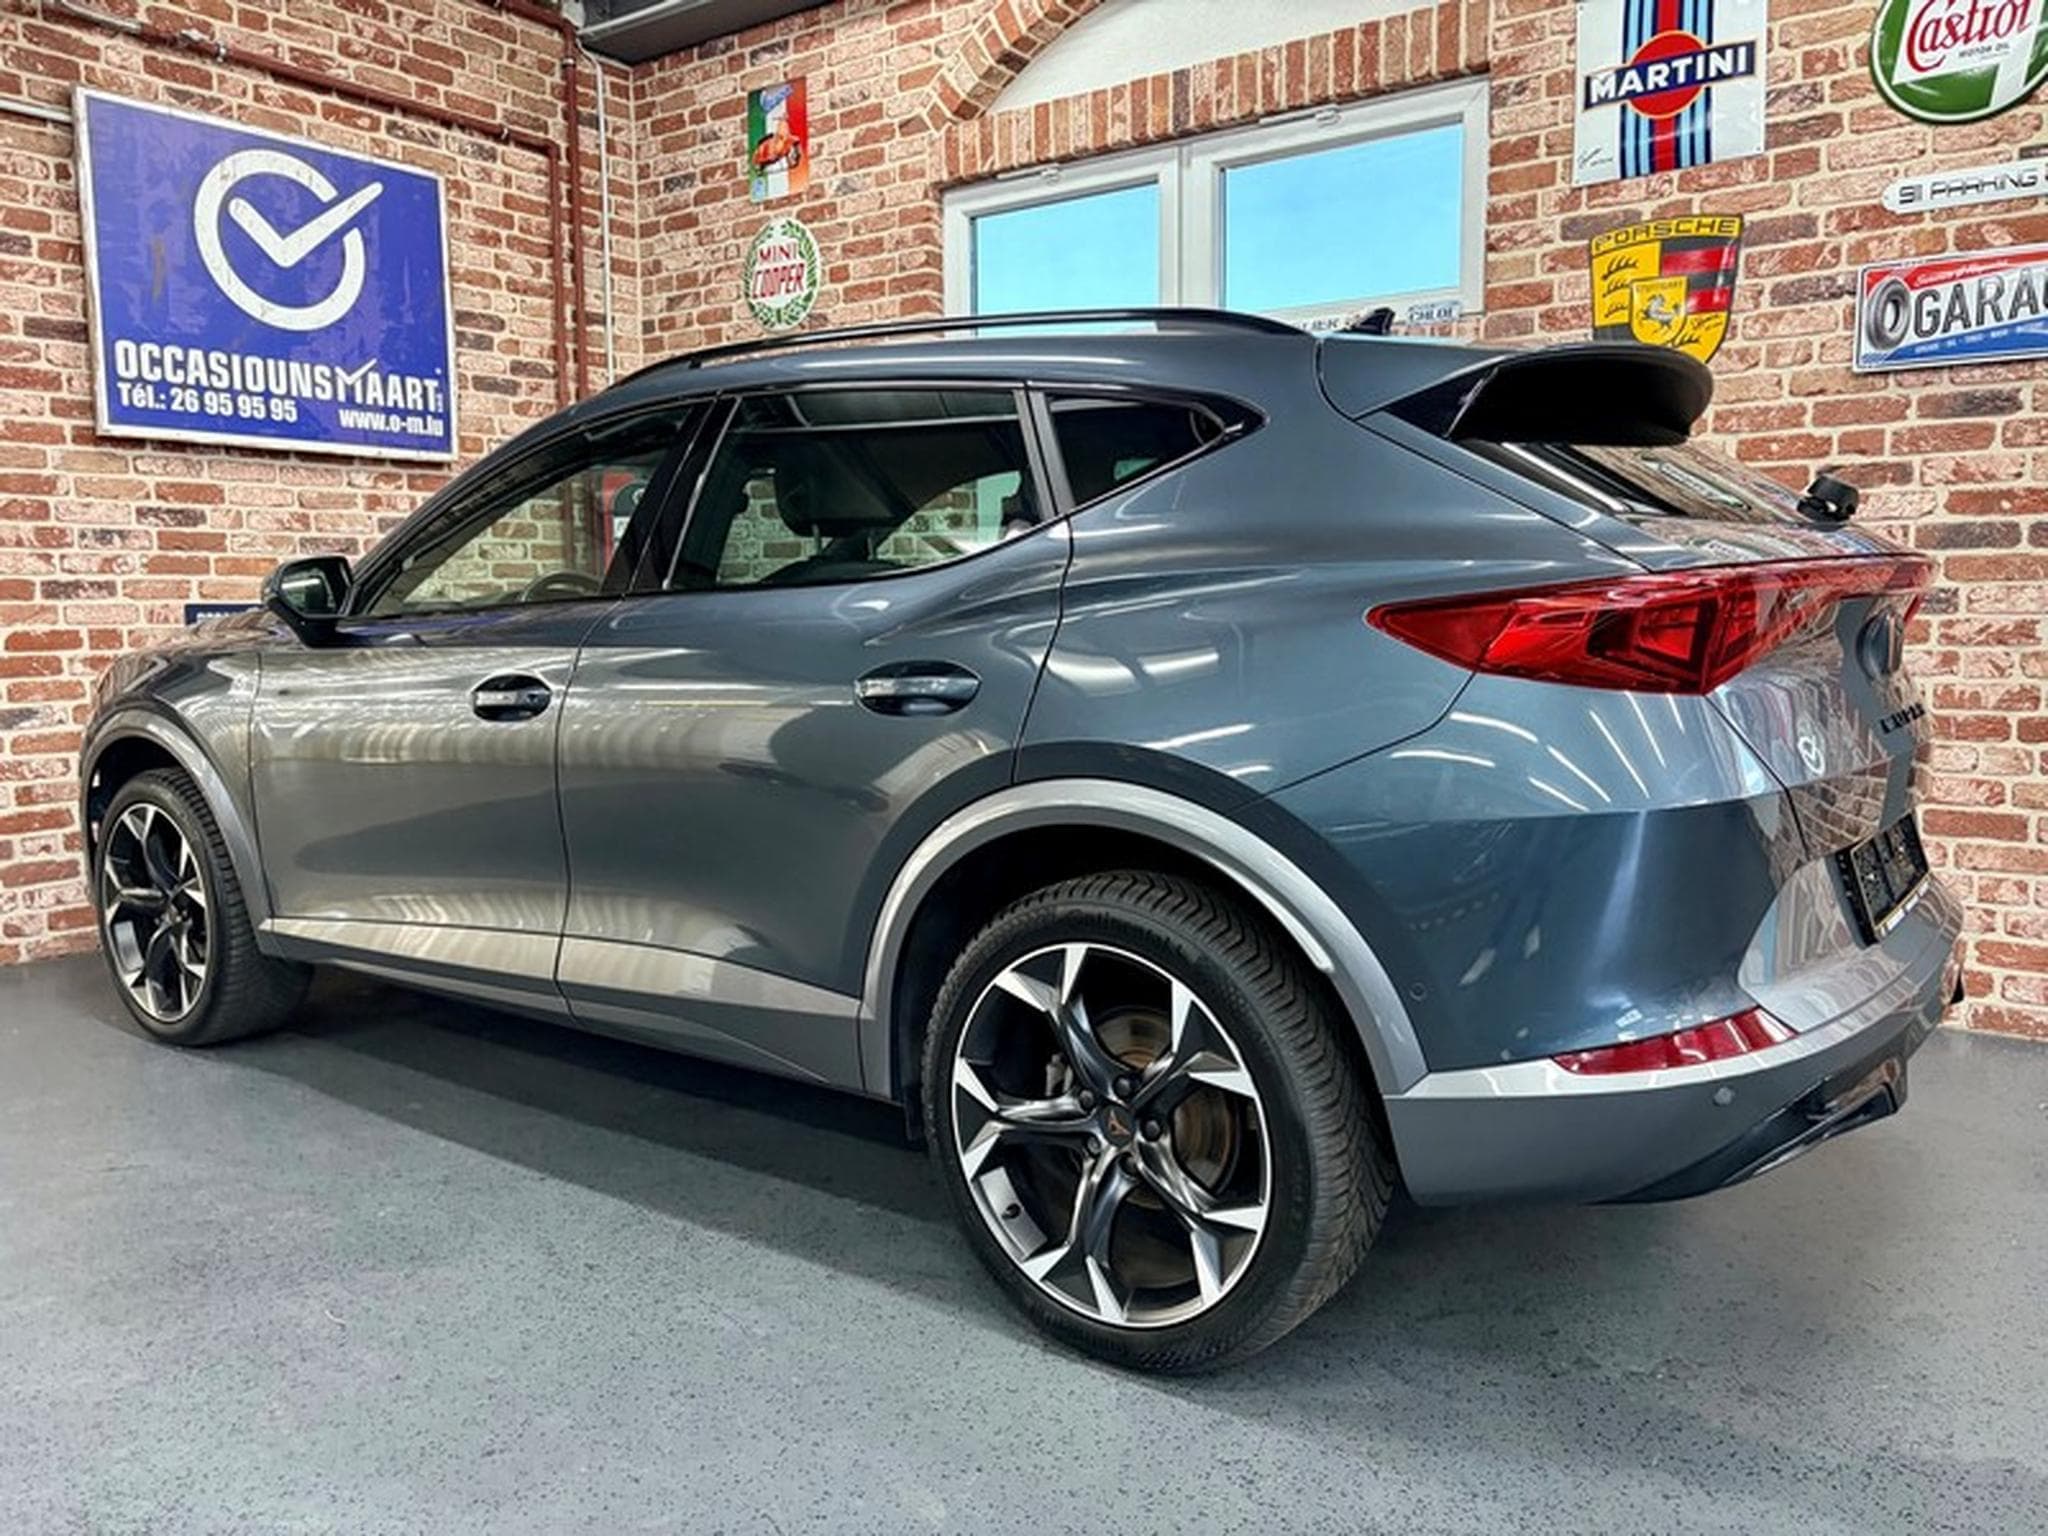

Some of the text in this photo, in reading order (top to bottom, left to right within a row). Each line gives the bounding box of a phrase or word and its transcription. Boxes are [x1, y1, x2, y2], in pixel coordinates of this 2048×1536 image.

[1907, 0, 2034, 73] Castrol
[1590, 46, 1748, 104] MARTINI
[1930, 167, 2039, 200] PARKING
[1594, 218, 1737, 252] PORSCHE
[759, 243, 797, 263] MINI
[752, 263, 805, 299] COOPER
[117, 381, 298, 423] Tél.: 26 95 95 95
[338, 408, 444, 437] www.o-m.lu
